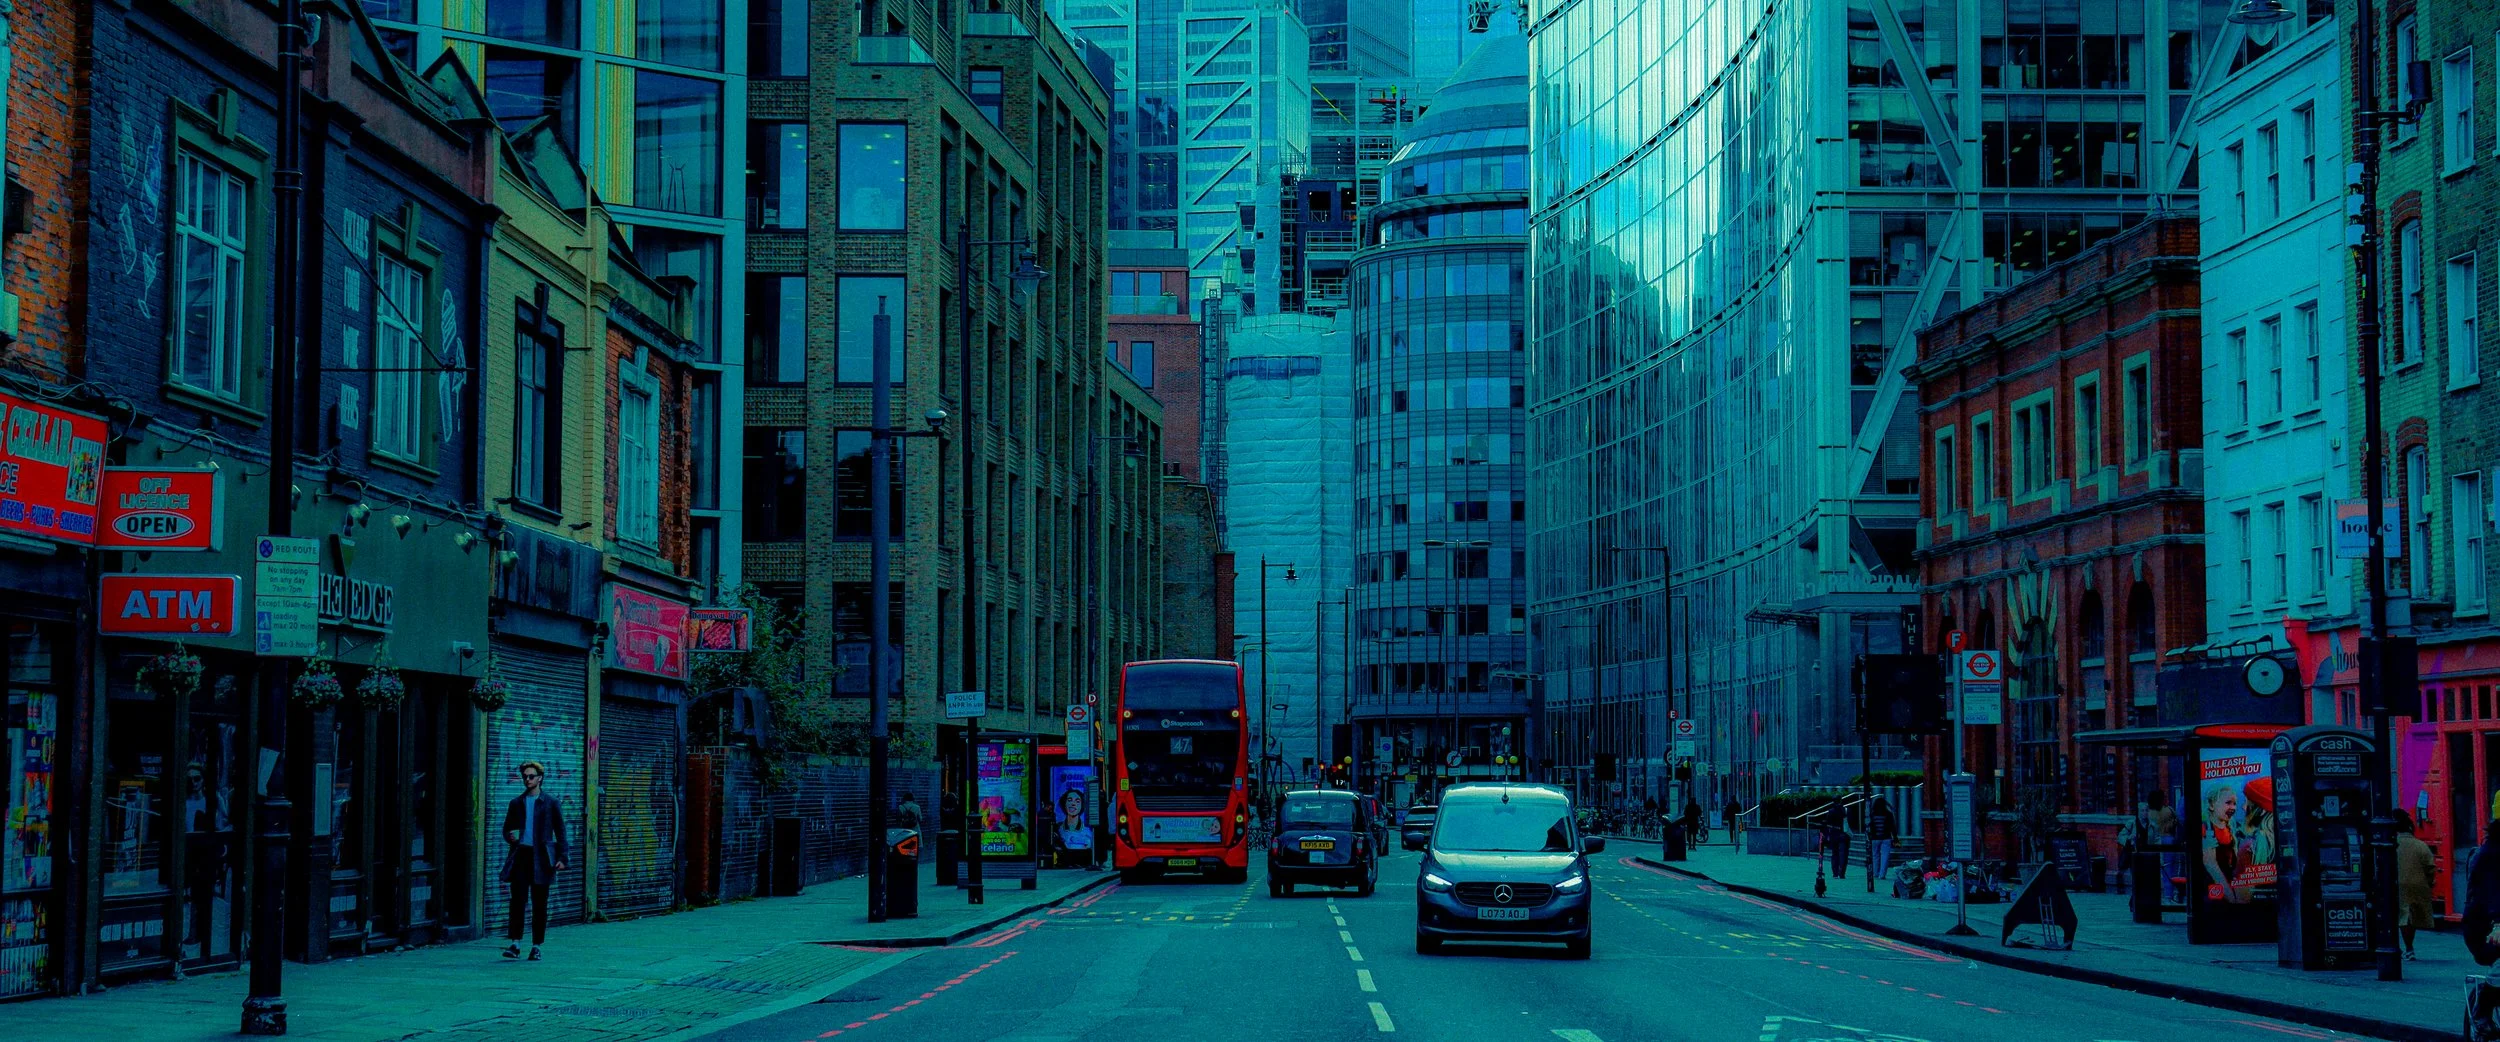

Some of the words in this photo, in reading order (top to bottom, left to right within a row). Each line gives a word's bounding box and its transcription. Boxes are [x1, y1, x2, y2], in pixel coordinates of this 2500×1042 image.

[7, 405, 73, 467] CELLAR
[139, 477, 172, 493] OFF
[119, 493, 190, 509] LICENCE
[126, 516, 177, 533] OPEN
[2341, 520, 2393, 534] hoe
[275, 544, 290, 553] RED
[293, 545, 317, 554] ROUTE
[279, 567, 309, 576] stopping
[120, 589, 212, 619] ATM
[350, 577, 394, 625] EDGE
[273, 613, 298, 621] loading
[1908, 613, 1916, 645] THE
[1951, 632, 1962, 648] F
[2336, 647, 2361, 671] hous
[1088, 693, 1097, 703] D
[1670, 710, 1676, 719] E
[1170, 720, 1204, 728] Stagecoach
[1173, 738, 1190, 753] 47
[2320, 737, 2351, 750] cash
[2204, 757, 2245, 769] UNLEASH
[2204, 767, 2240, 779] HOLIDAY
[2242, 764, 2260, 773] YOU
[1481, 909, 1505, 918] LO73
[2328, 905, 2363, 920] cash
